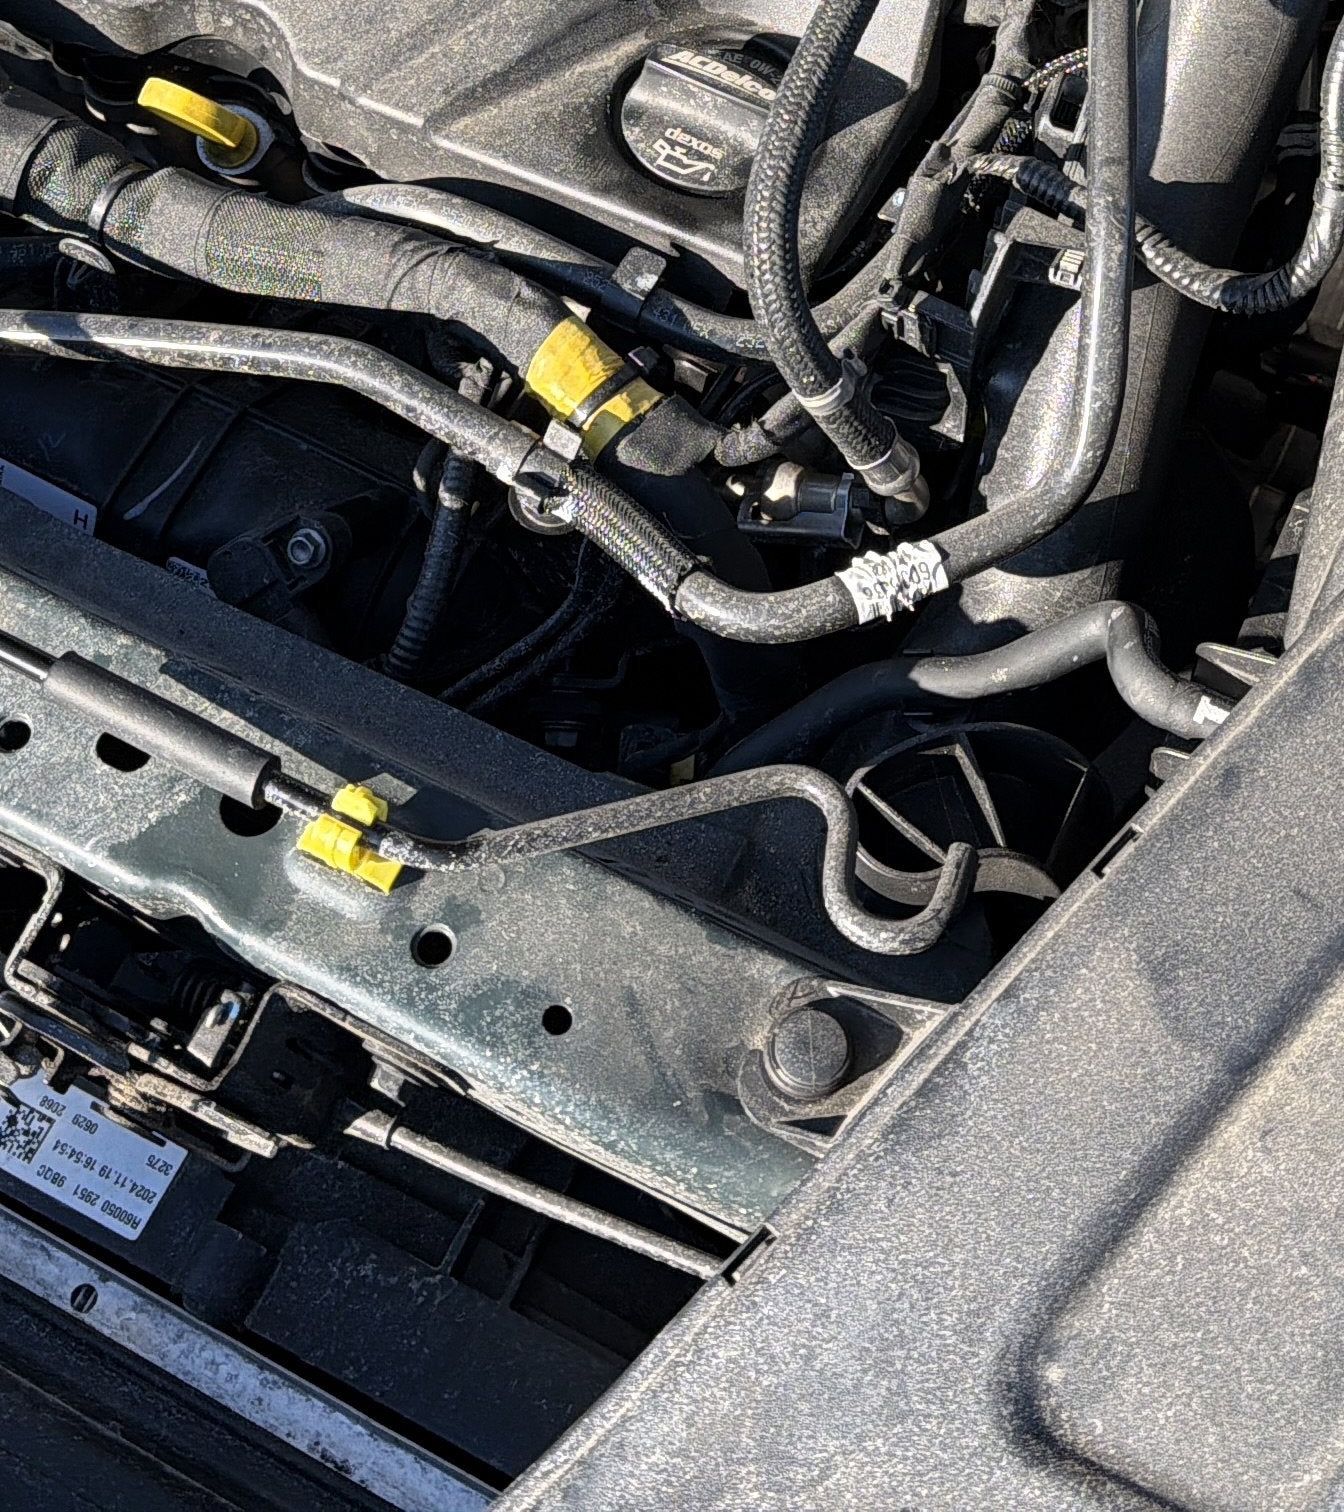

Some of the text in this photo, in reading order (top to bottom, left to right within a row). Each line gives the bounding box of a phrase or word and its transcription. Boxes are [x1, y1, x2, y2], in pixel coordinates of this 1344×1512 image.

[668, 50, 777, 102] ACDelco
[664, 126, 725, 160] dexos
[73, 509, 89, 529] H
[39, 1095, 174, 1177] 3275 0629 2068
[52, 1139, 157, 1205] 2024.11.19 16:54:54
[72, 1183, 99, 1207] 2951
